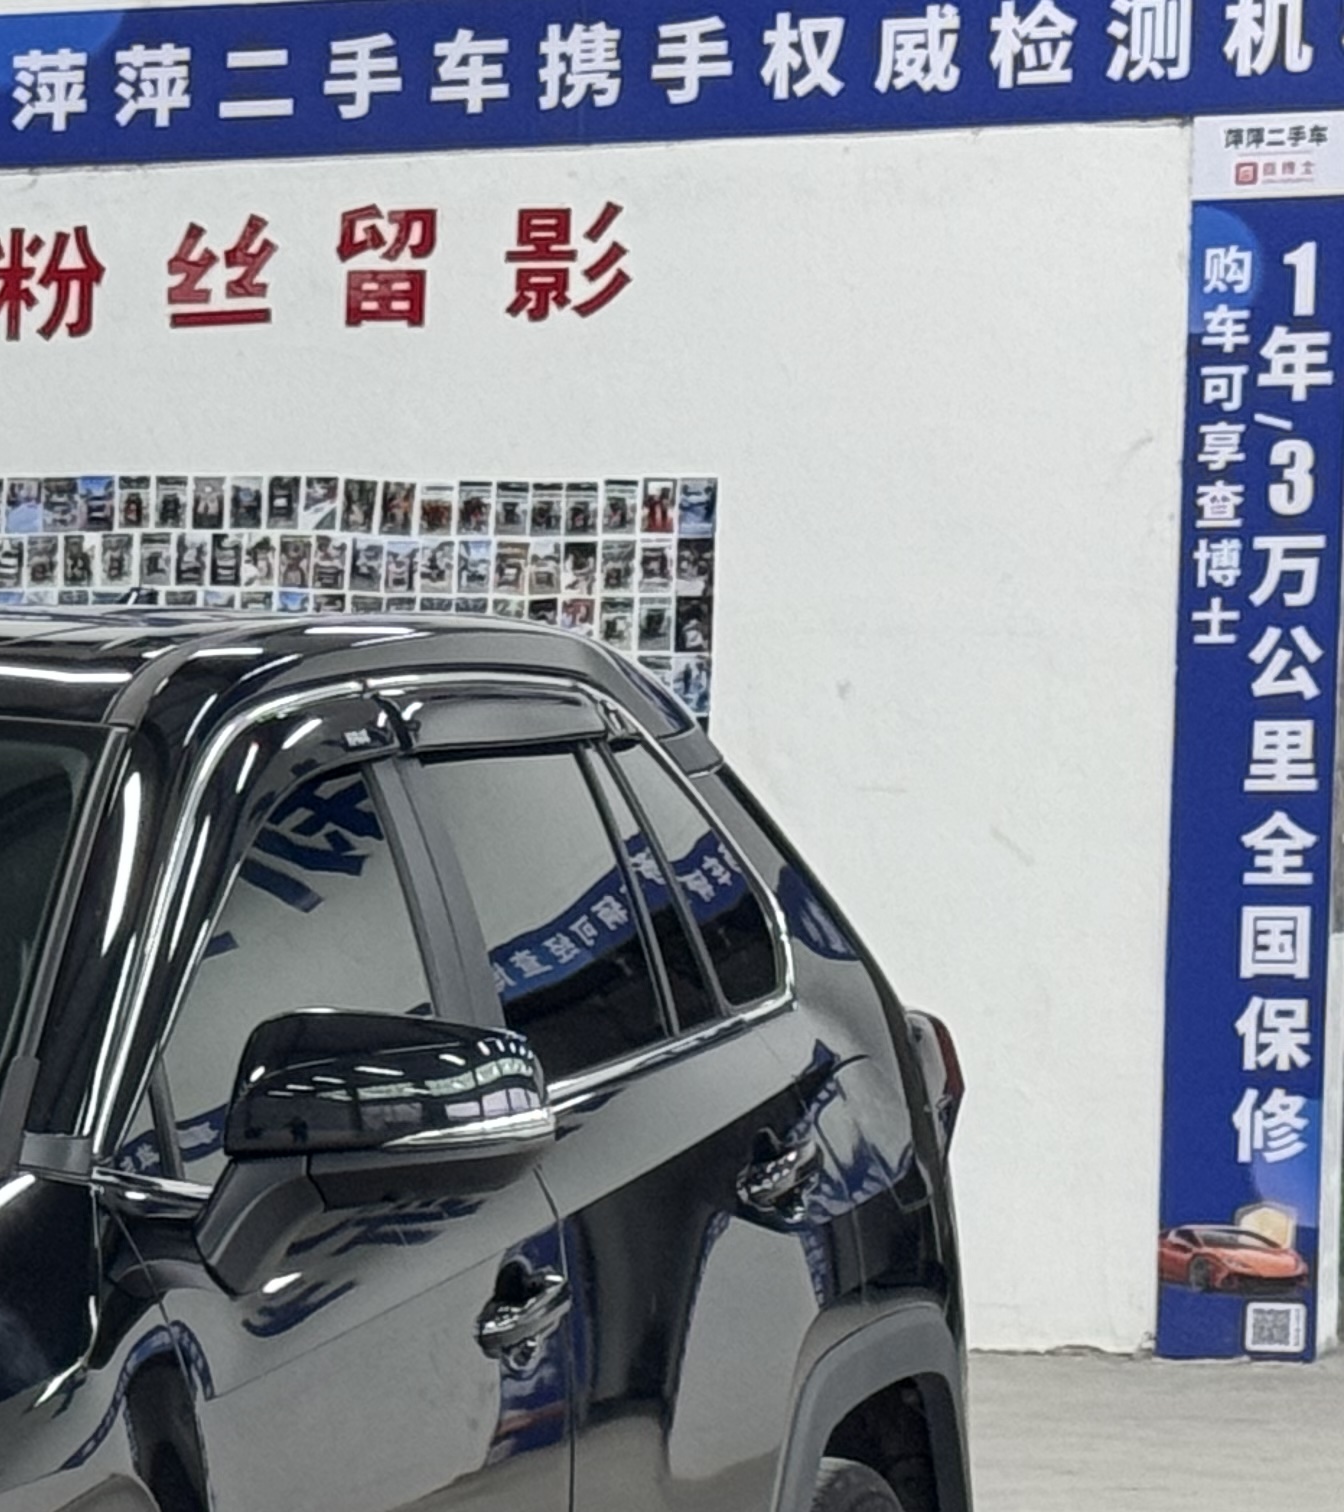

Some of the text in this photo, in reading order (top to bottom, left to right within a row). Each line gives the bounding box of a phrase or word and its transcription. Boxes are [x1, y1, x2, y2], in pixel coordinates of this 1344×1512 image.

[9, 0, 1344, 132] 萍萍二手车携手权威检测机
[1191, 245, 1253, 645] 购车可享查博士
